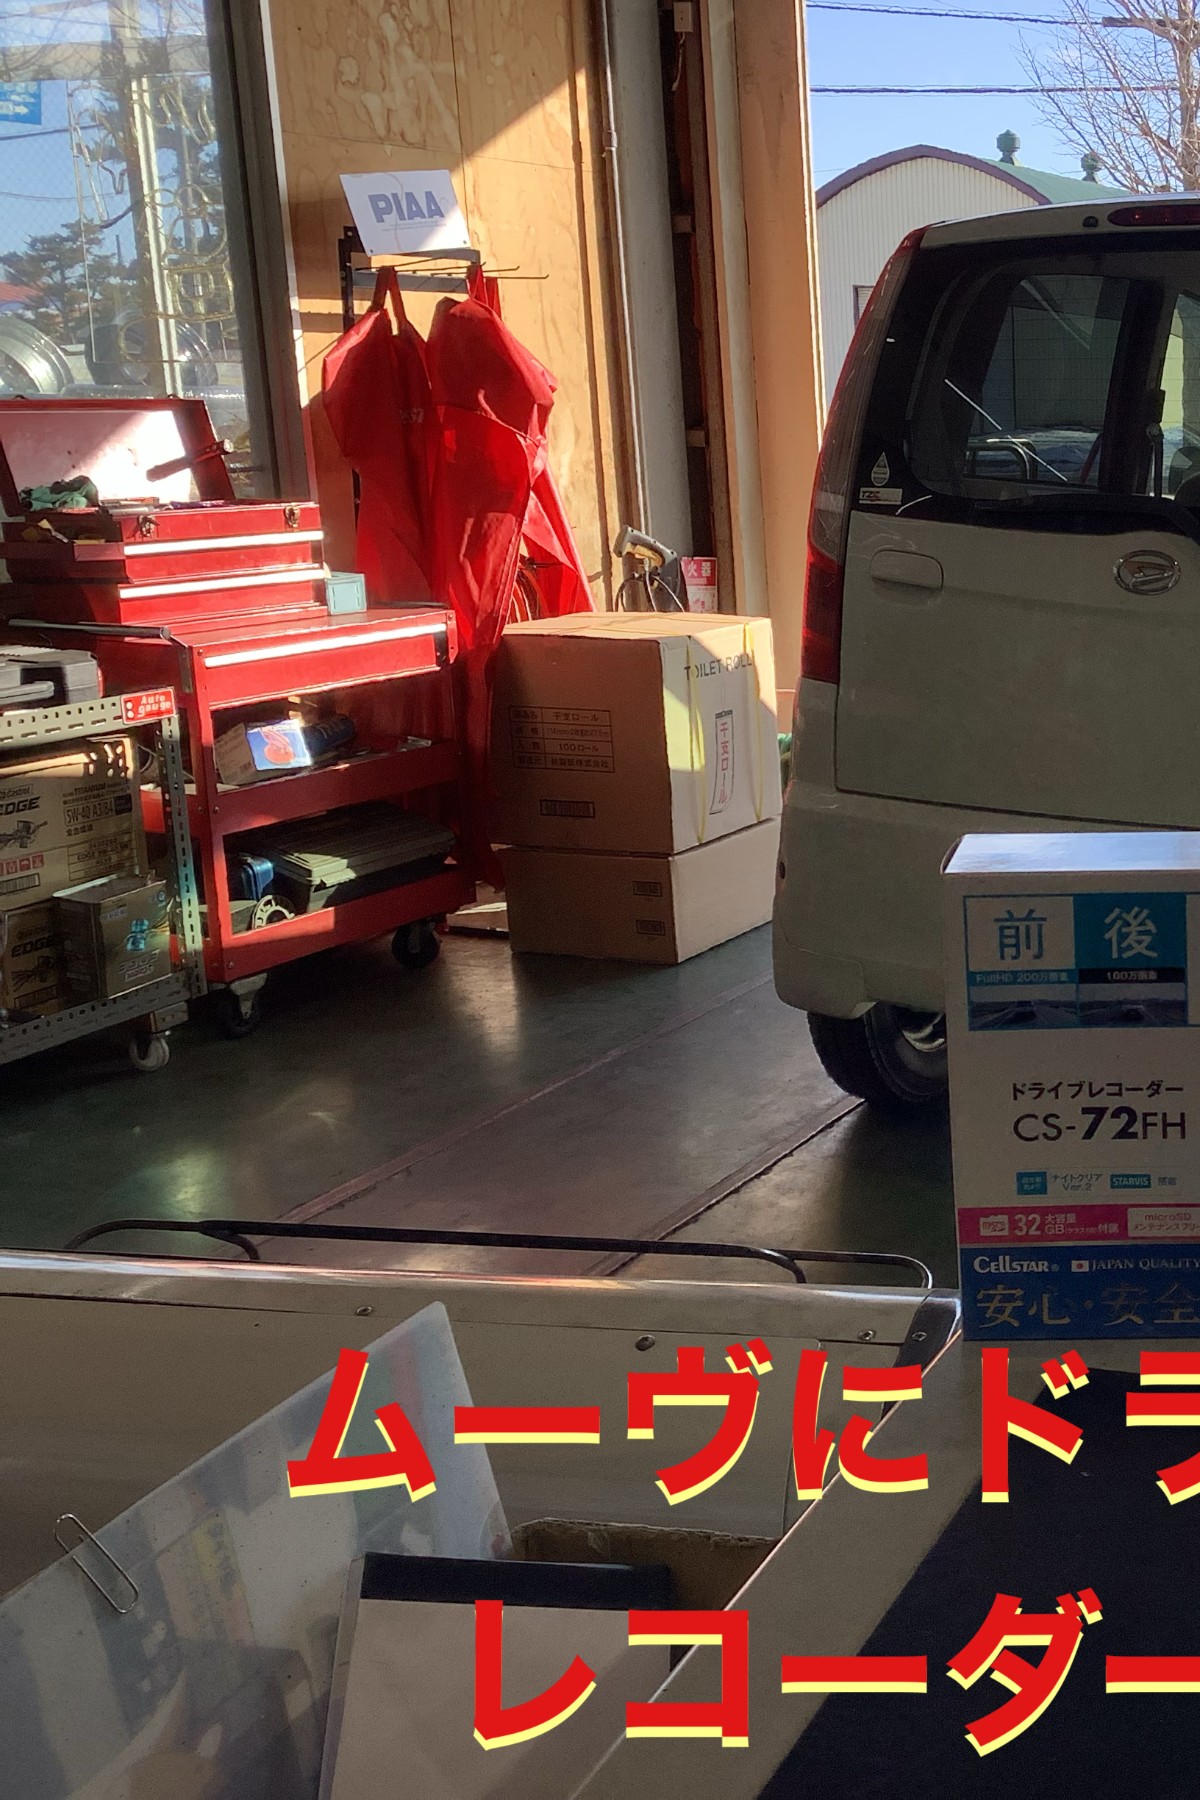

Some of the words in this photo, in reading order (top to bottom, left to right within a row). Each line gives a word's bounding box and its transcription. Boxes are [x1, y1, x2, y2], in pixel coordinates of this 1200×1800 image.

[368, 191, 445, 223] PIAA
[726, 654, 753, 672] ROLL
[140, 693, 166, 705] Auto
[138, 700, 172, 718] gauge
[718, 721, 730, 805] 干支ロール
[993, 907, 1048, 962] 前
[1103, 906, 1159, 961] 後
[1011, 1081, 1184, 1101] ドライブレコーダー
[1012, 1106, 1187, 1142] CS-72FH
[1051, 1173, 1103, 1183] ナイトクリア
[1112, 1176, 1150, 1187] STARVIS
[1013, 1214, 1042, 1236] 32
[1044, 1213, 1076, 1224] 大容量
[1144, 1212, 1192, 1222] microSD
[1091, 1259, 1135, 1271] JAPAN
